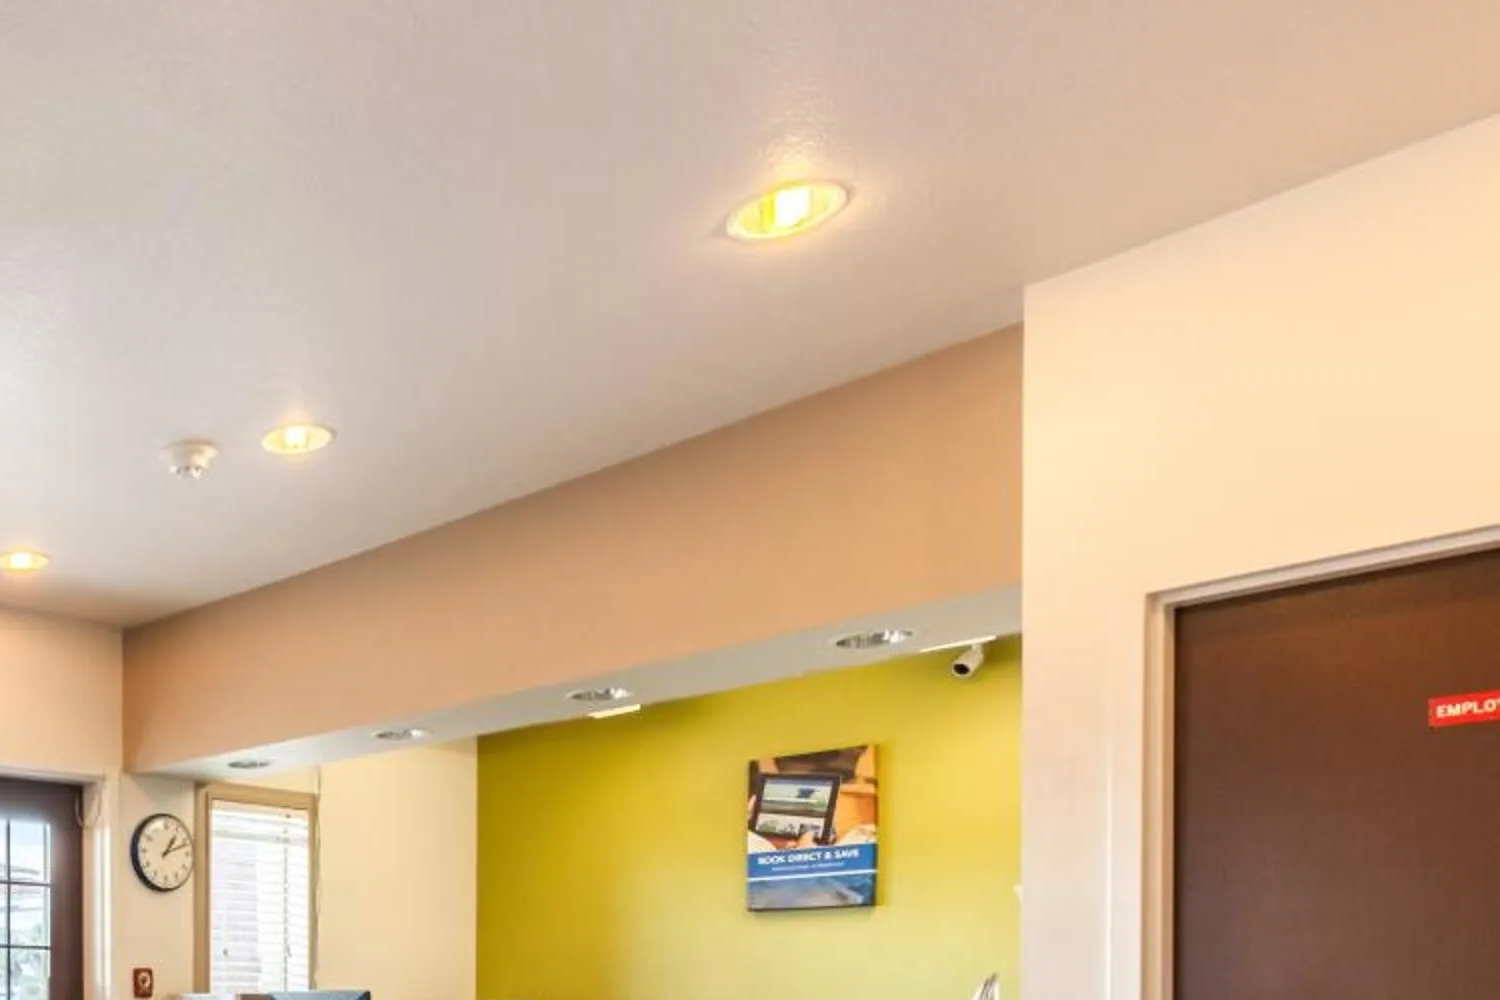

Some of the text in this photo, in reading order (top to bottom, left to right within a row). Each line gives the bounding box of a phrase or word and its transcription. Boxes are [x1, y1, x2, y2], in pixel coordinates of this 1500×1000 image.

[757, 855, 786, 865] BOOK
[787, 852, 822, 863] DIRECT
[834, 848, 859, 859] SAVE
